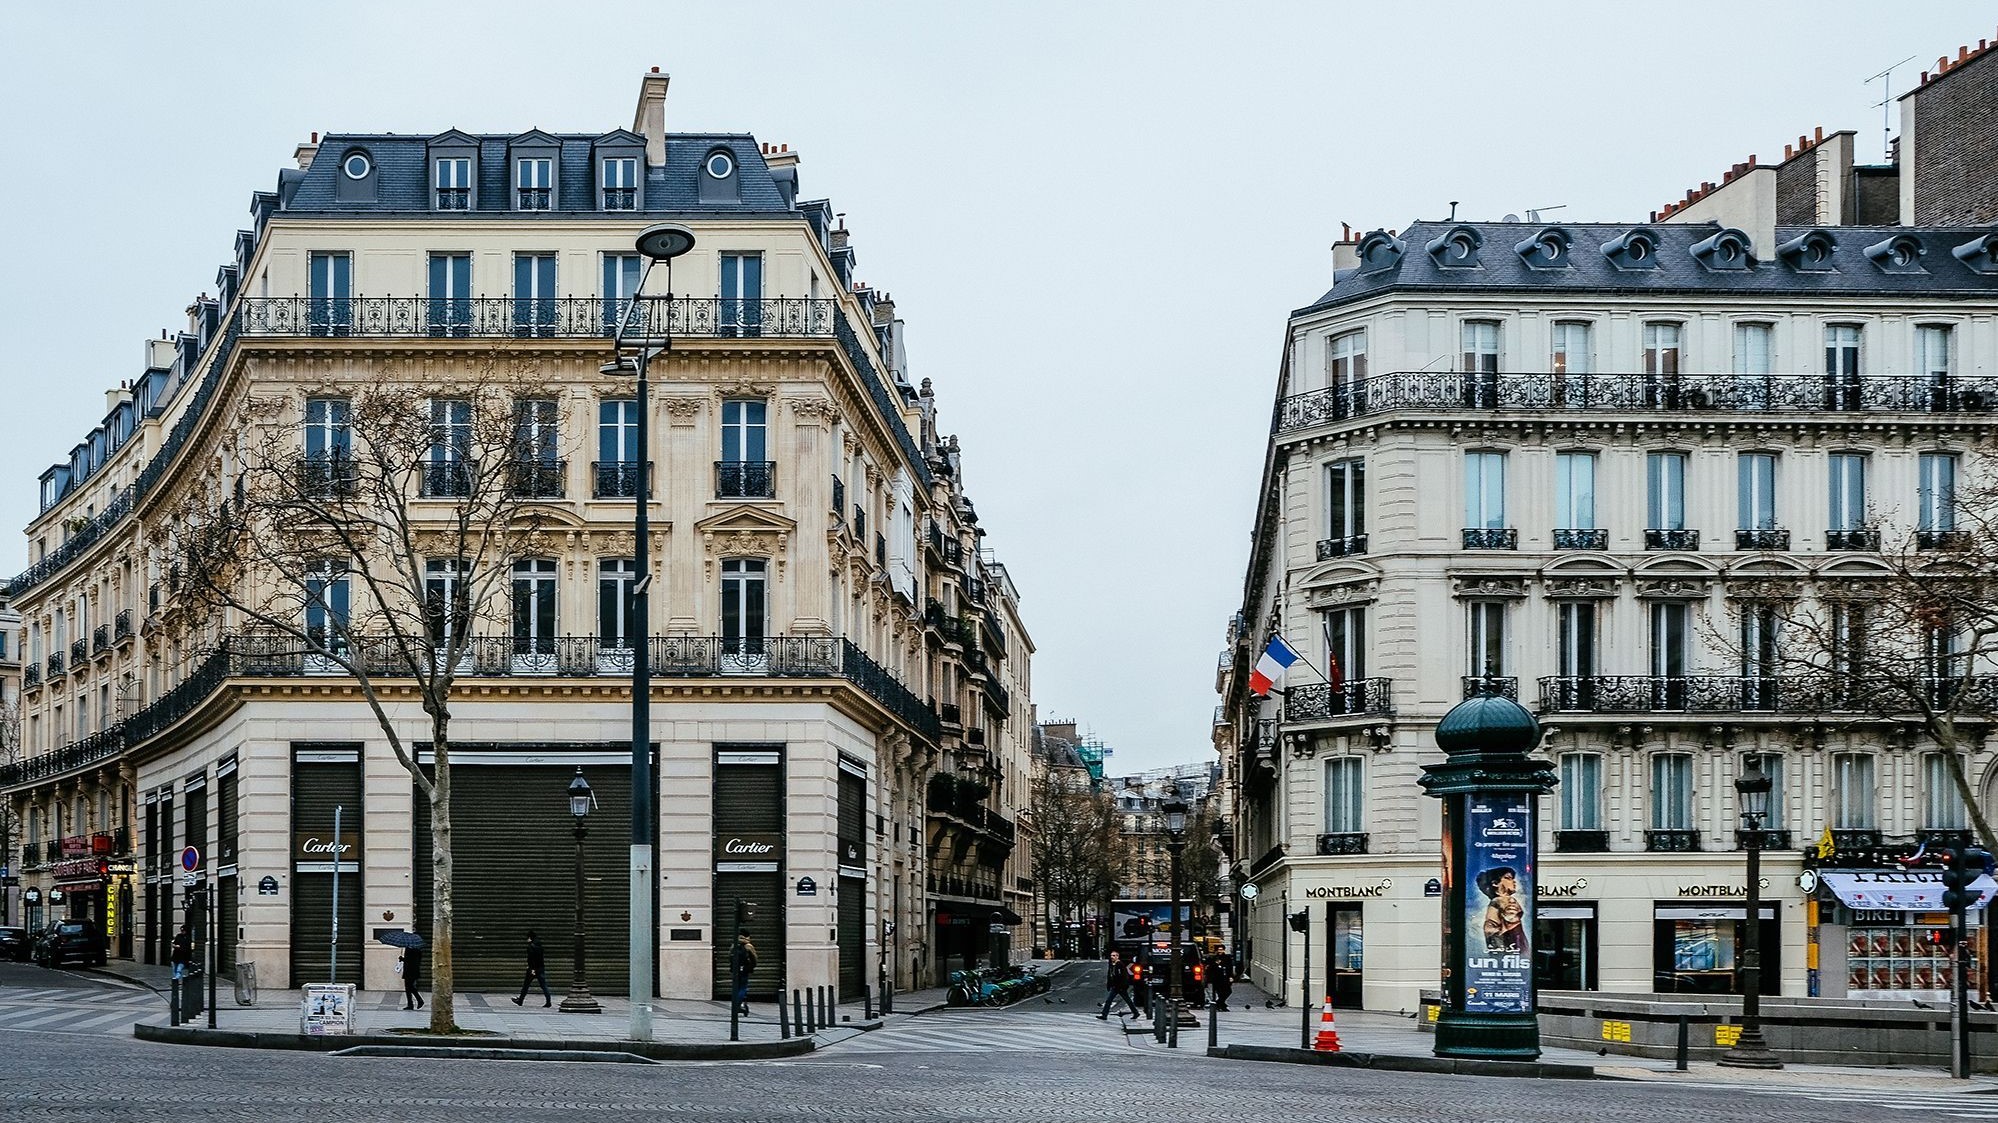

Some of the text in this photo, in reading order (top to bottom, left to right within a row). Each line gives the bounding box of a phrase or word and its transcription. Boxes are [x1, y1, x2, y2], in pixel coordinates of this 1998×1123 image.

[303, 837, 351, 853] Cartier
[725, 838, 774, 854] Cartier
[107, 864, 133, 872] CHANGE
[1306, 886, 1383, 898] MONTBLANC
[1537, 885, 1577, 896] BLANC
[1678, 885, 1749, 897] MONTBLAN
[106, 886, 115, 935] CHANGE
[1468, 954, 1531, 969] un fils
